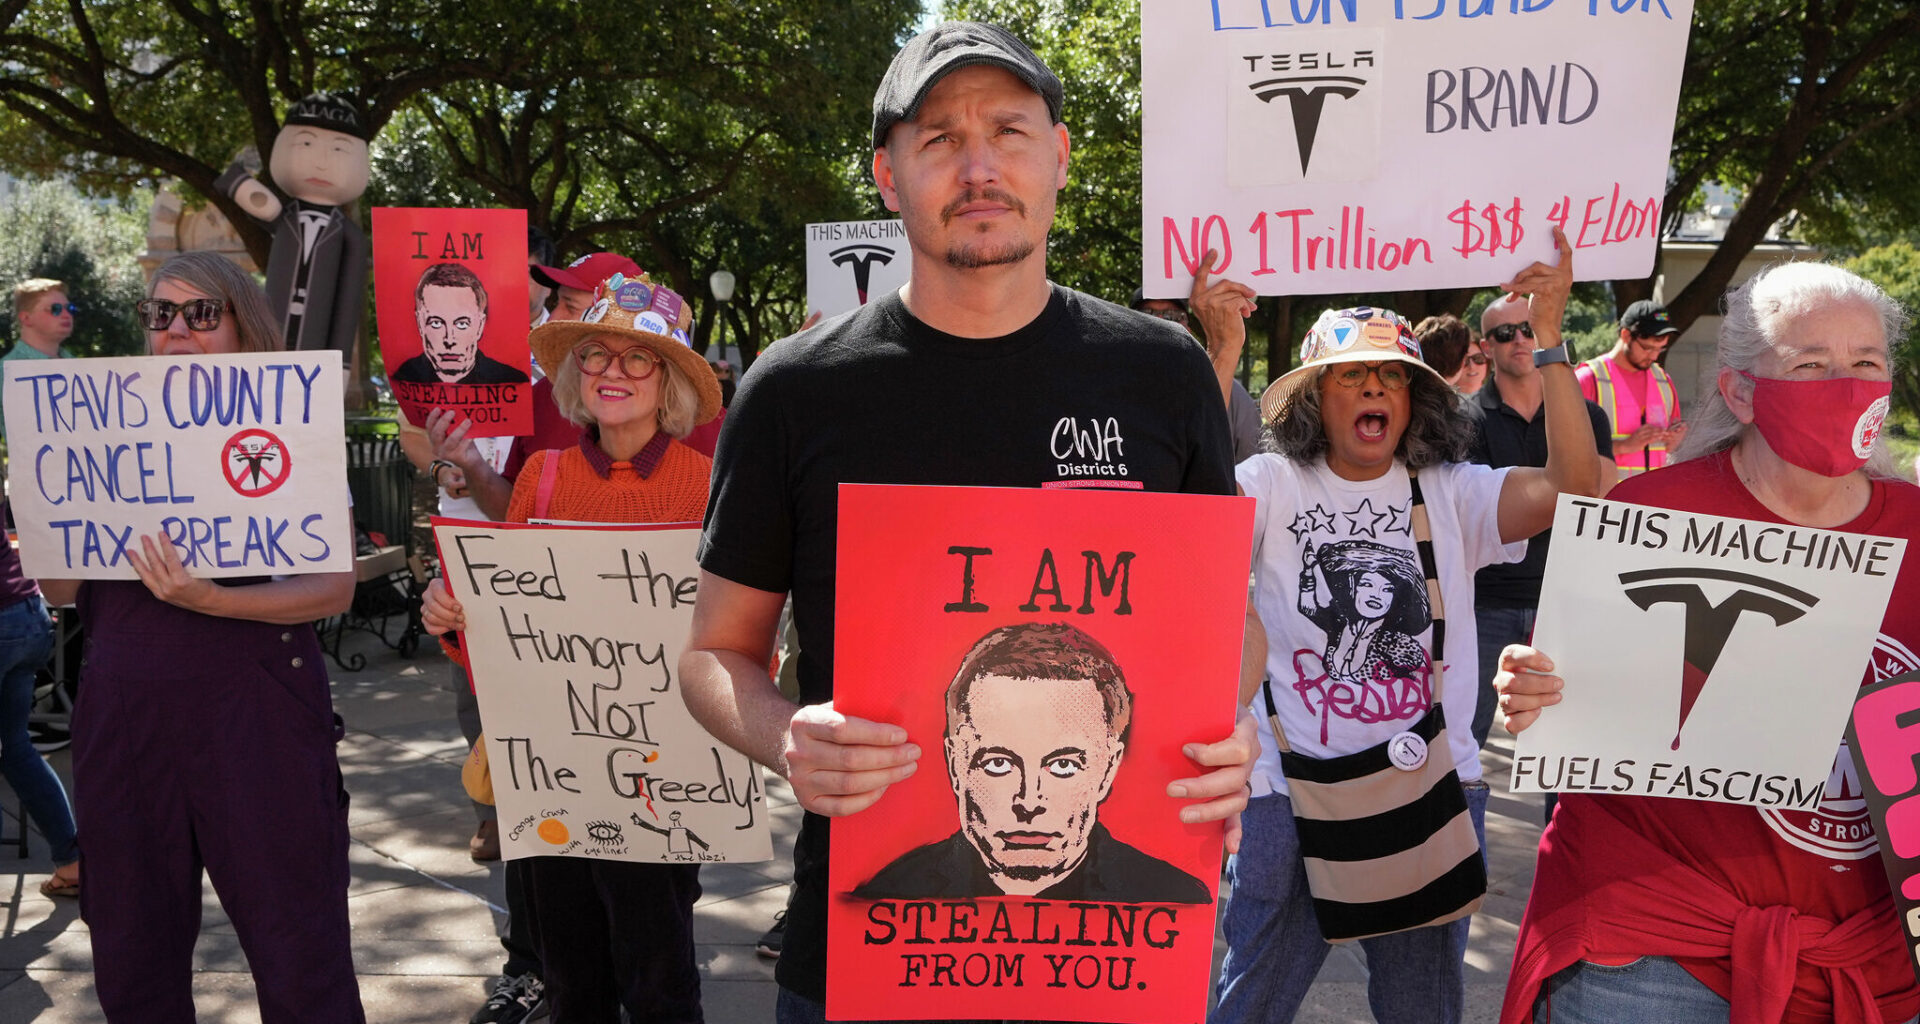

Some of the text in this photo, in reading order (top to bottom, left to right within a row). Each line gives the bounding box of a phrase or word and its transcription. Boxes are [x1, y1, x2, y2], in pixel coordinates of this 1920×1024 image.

[1242, 50, 1375, 72] TESLA
[300, 103, 358, 127] MAGA
[1426, 62, 1599, 134] BRAND
[411, 231, 484, 260] I AM
[811, 222, 905, 241] THIS MACHIN
[1163, 214, 1233, 280] NO
[1276, 205, 1433, 273] Trillion
[1447, 197, 1524, 259] $$$
[1546, 195, 1570, 250] 4
[640, 317, 663, 334] TACO
[14, 363, 321, 433] TRAVIS COUNTY
[399, 382, 518, 405] STEALING
[1050, 417, 1124, 462] CWA
[35, 442, 195, 505] CANCEL
[1057, 462, 1129, 476] District 6
[48, 513, 330, 568] TAX BREAKS
[1571, 500, 1895, 576] THIS MACHINE
[455, 535, 697, 609] Feed the
[944, 546, 1136, 615] I AM
[500, 606, 671, 693] Hungry
[567, 679, 655, 744] NOT
[1292, 648, 1451, 747] Resist
[495, 737, 761, 830] The Greedy!
[1514, 756, 1635, 792] FUELS
[1647, 763, 1826, 810] FASCISM
[509, 807, 569, 841] Orange Crush
[558, 840, 582, 855] with
[1809, 817, 1874, 840] STRON
[698, 851, 726, 862] Nazi
[864, 901, 1179, 949] STEALING
[898, 953, 1147, 991] FROM YOU.
